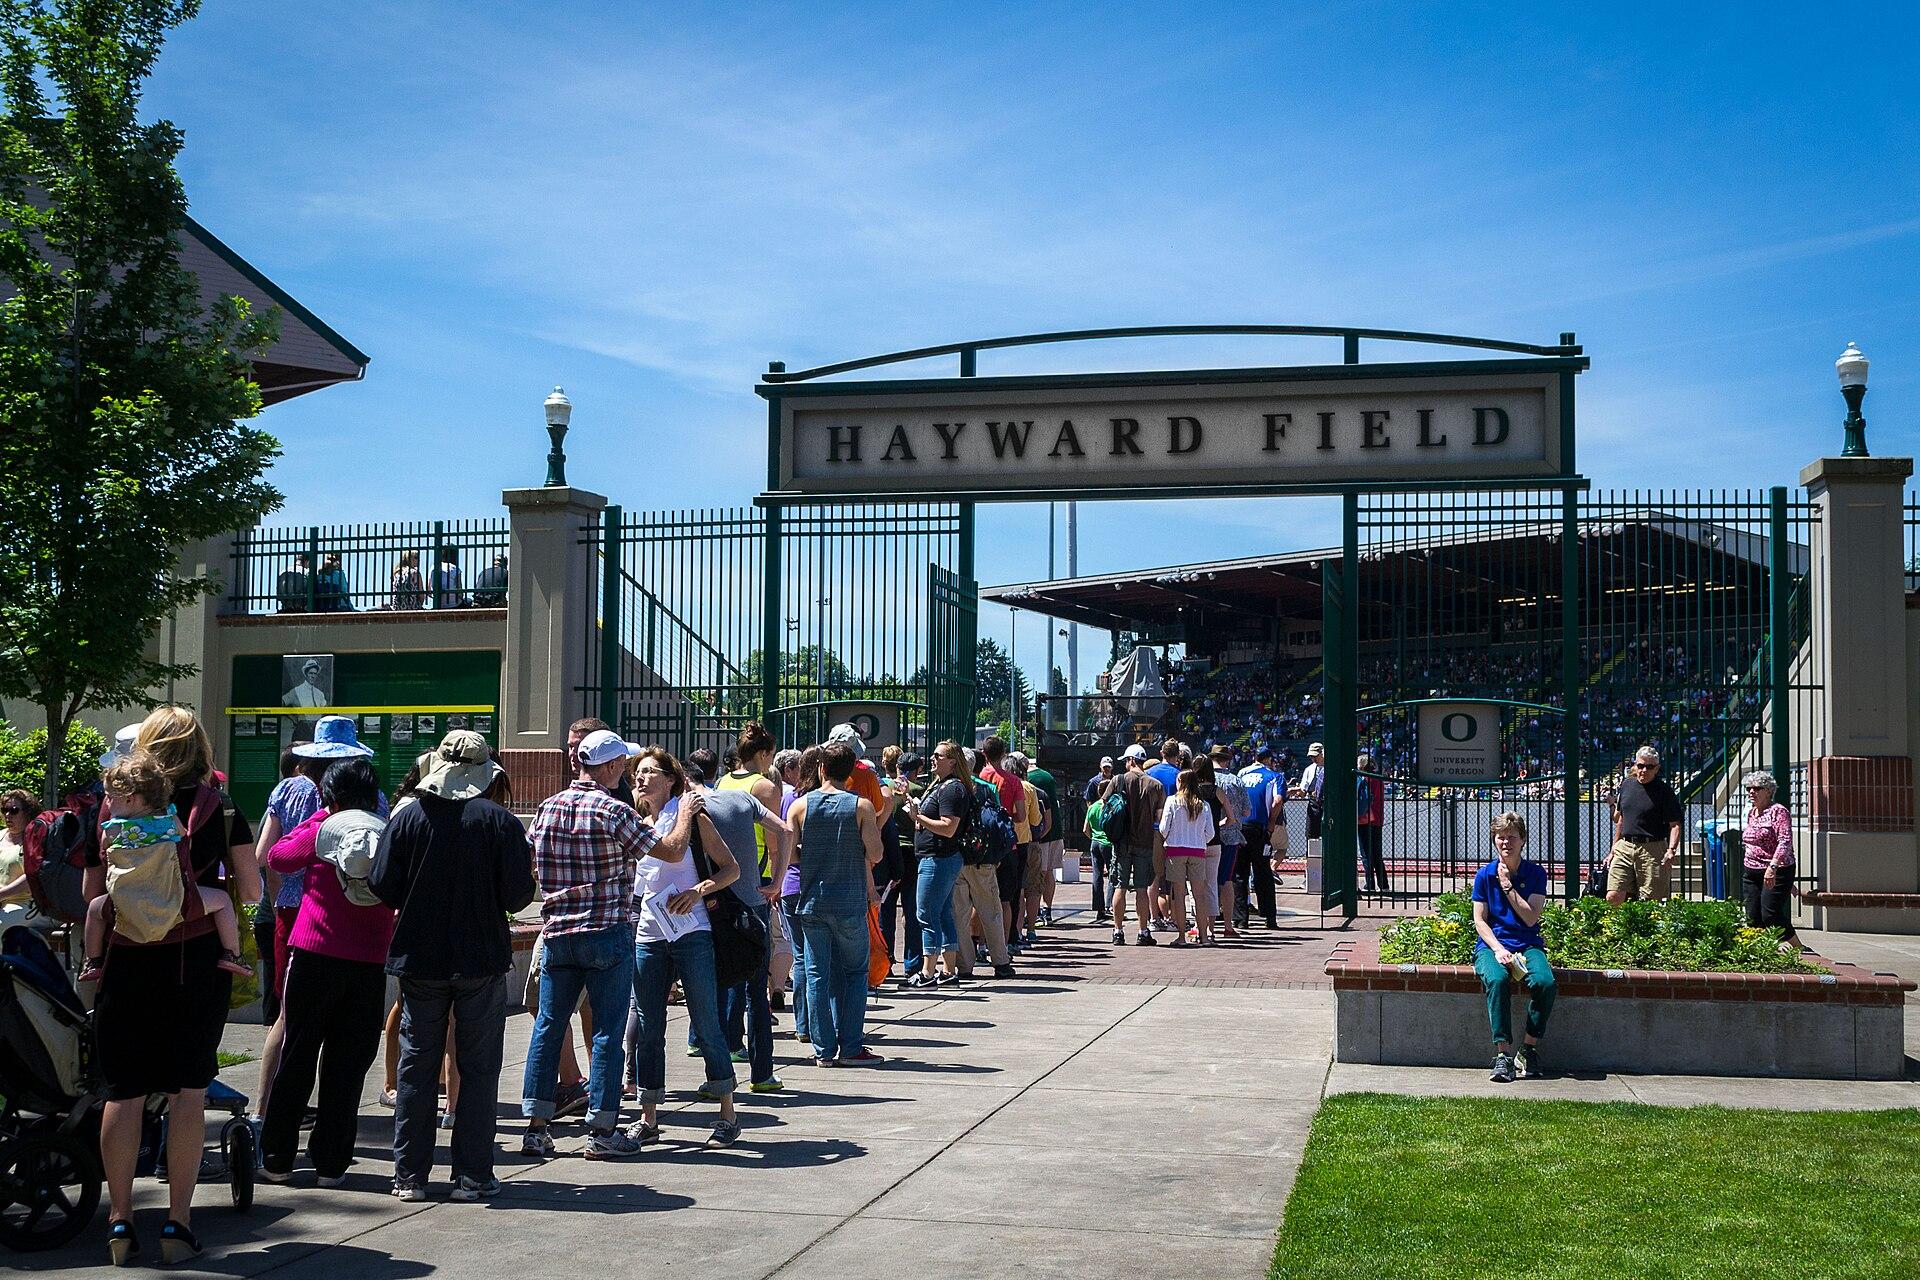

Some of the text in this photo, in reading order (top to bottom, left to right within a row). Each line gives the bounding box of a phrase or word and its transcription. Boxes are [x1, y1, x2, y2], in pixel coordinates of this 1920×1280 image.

[825, 407, 1511, 463] HAYWARD FIELD
[1441, 712, 1478, 743] O
[1433, 756, 1485, 765] UNIVERSITY
[1433, 767, 1485, 776] OF OREGON
